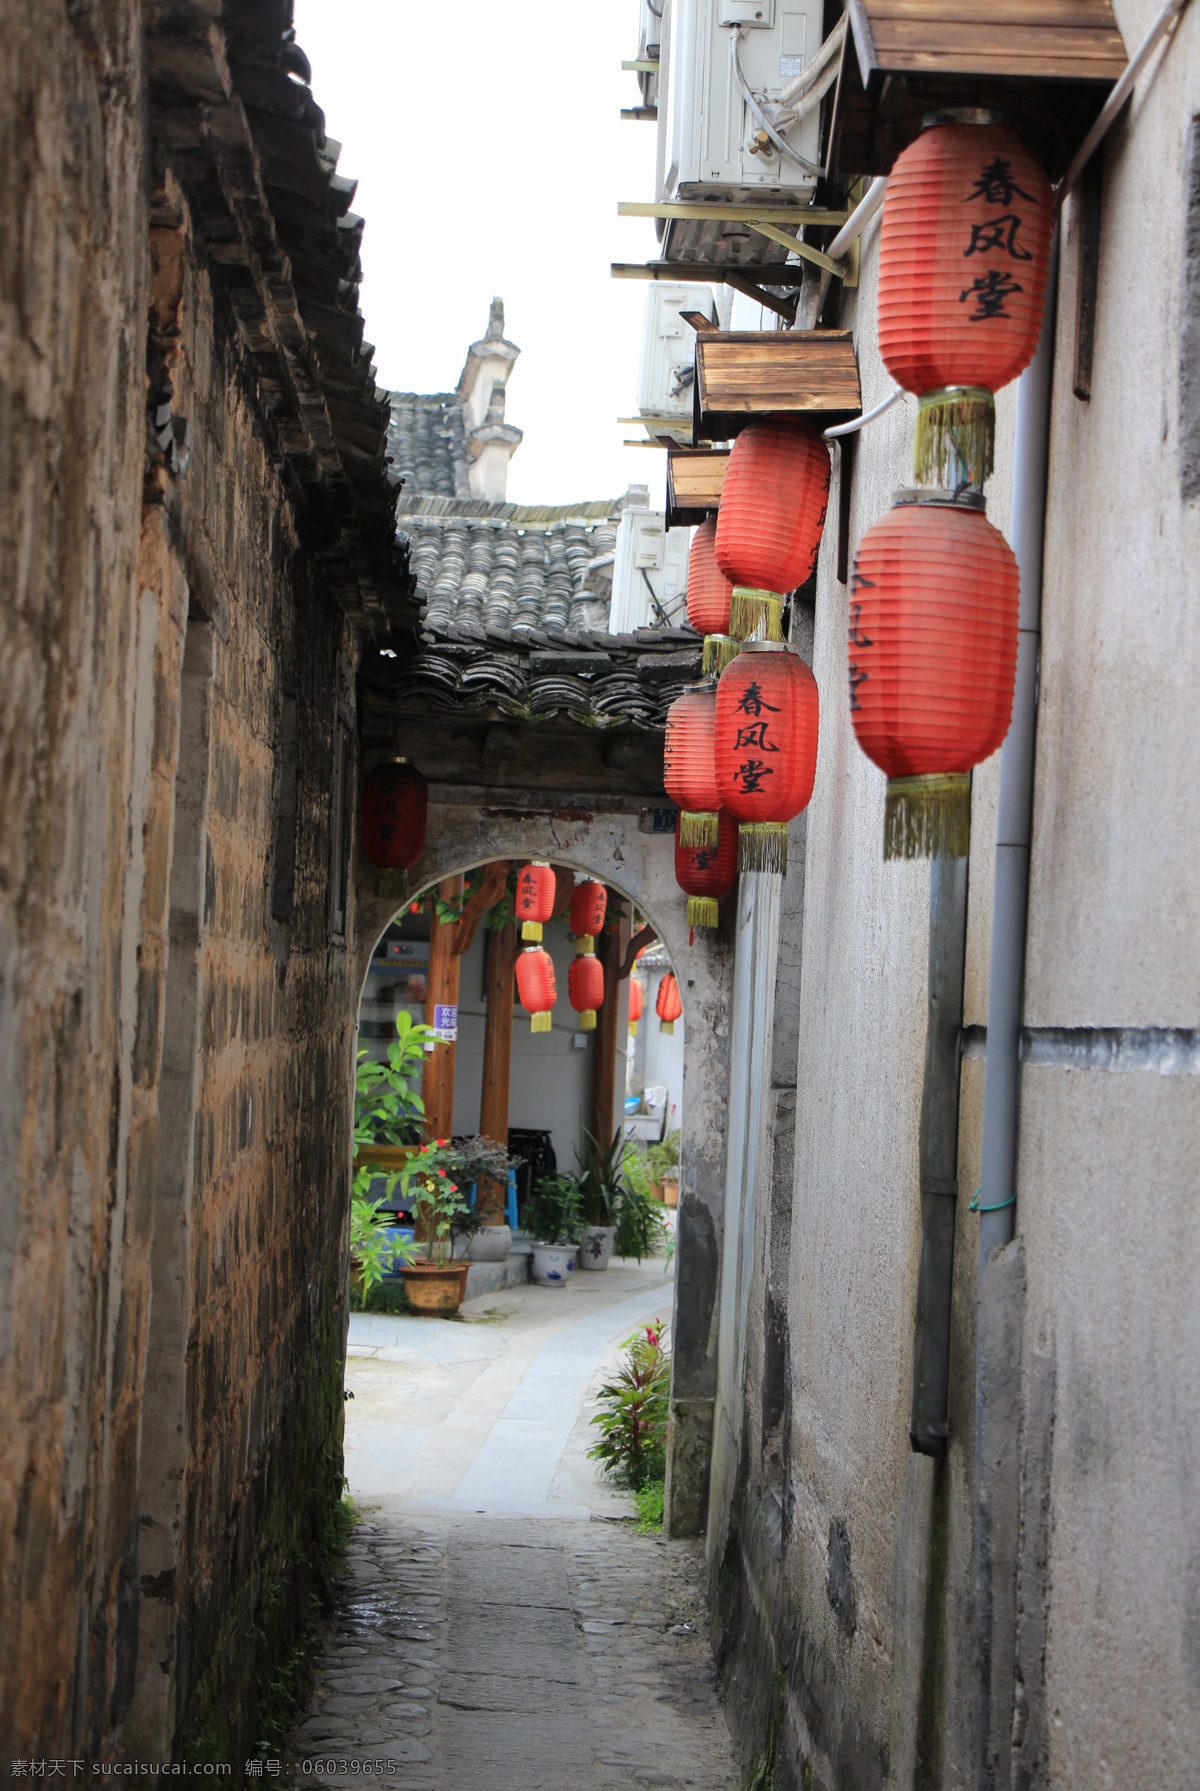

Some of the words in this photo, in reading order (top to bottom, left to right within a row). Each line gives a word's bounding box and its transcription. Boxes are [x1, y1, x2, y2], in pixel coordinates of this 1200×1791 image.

[959, 157, 1040, 322] 春风堂
[732, 681, 782, 794] 春风堂
[521, 872, 538, 909] 春风堂
